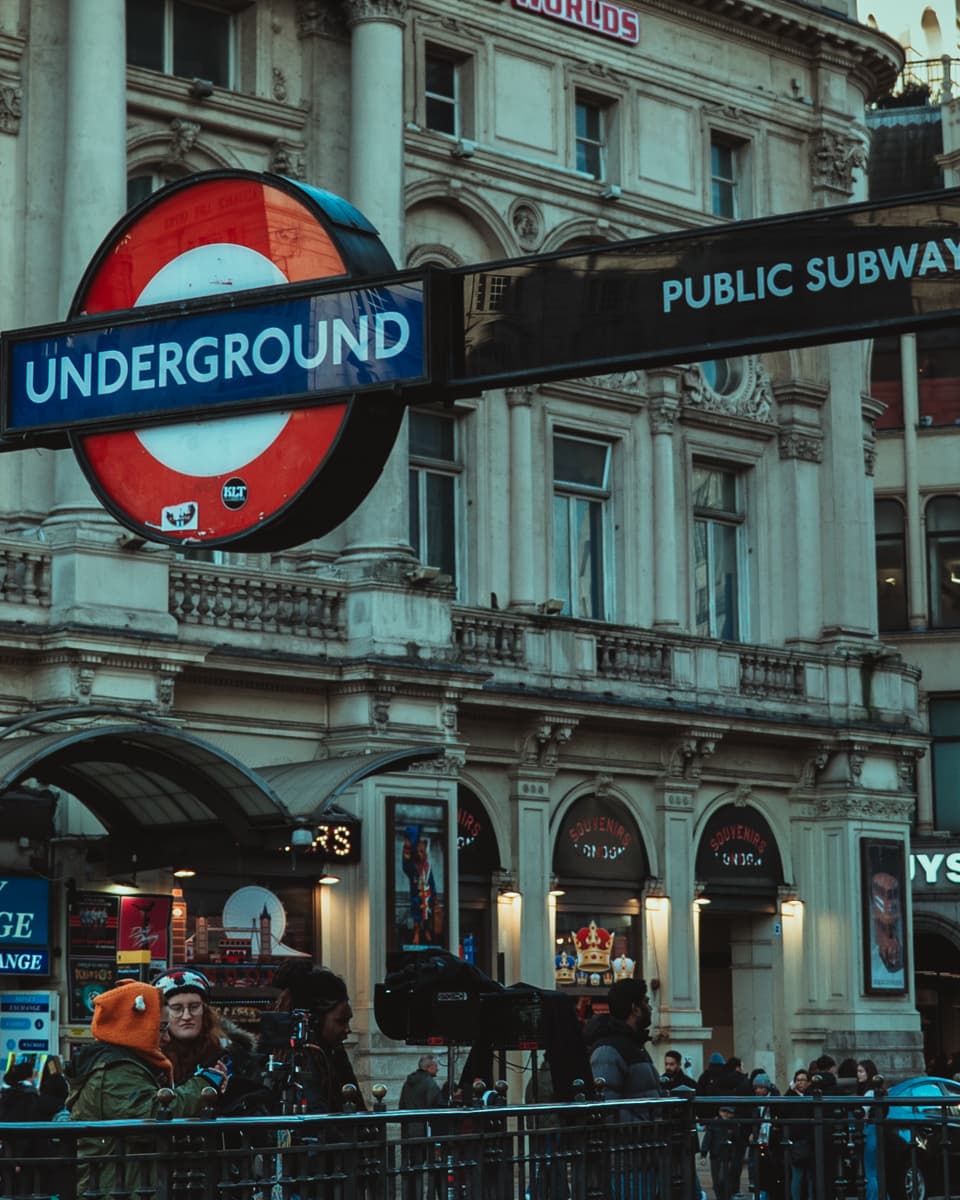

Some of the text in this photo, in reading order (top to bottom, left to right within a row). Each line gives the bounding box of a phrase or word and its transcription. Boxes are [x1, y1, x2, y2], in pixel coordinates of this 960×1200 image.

[662, 238, 960, 313] PUBLIC SUBWAY
[25, 311, 411, 404] UNDERGROUND
[223, 486, 247, 498] KLT
[568, 815, 632, 848] SOUVENIRS
[710, 825, 767, 853] SOUVENIRS
[573, 844, 626, 860] ONDON
